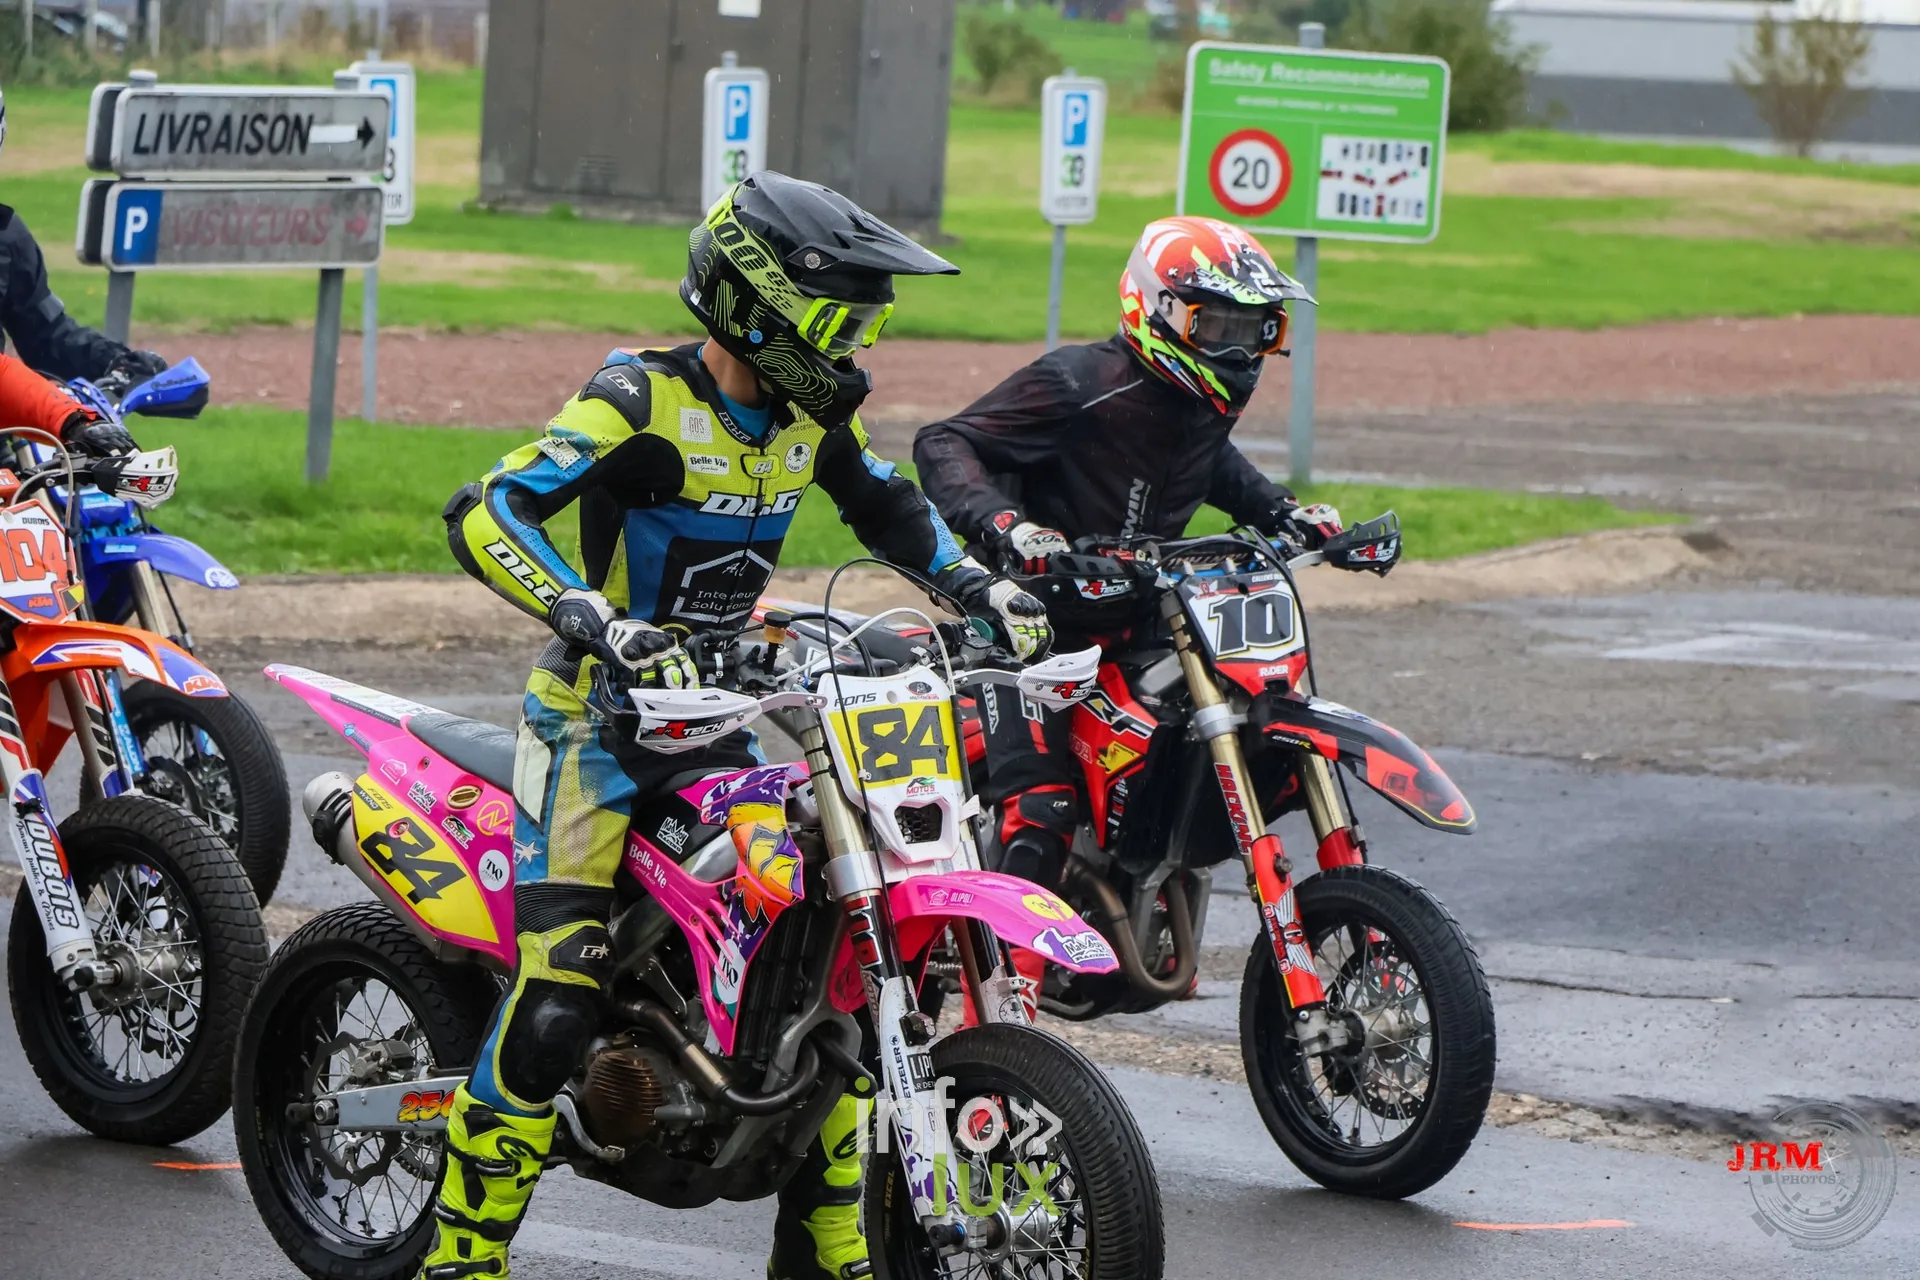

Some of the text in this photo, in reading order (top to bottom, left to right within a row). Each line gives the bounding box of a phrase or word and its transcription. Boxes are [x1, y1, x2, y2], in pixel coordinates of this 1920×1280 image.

[1208, 58, 1430, 90] Safety Recommendation
[131, 113, 314, 155] LIVRAISON
[1232, 156, 1270, 190] 20
[123, 206, 148, 250] P
[168, 204, 332, 247] VISITEURS
[689, 456, 713, 466] Belle
[714, 457, 728, 468] Vie
[22, 517, 51, 526] DUBOIS
[698, 489, 802, 518] DLG
[0, 528, 68, 583] 104
[1208, 591, 1296, 658] 10
[184, 675, 226, 694] KTM
[856, 705, 950, 783] 84
[368, 787, 394, 810] FONS
[25, 818, 80, 930] DUBOIS
[360, 815, 468, 906] 84
[629, 843, 668, 889] Belle Vie
